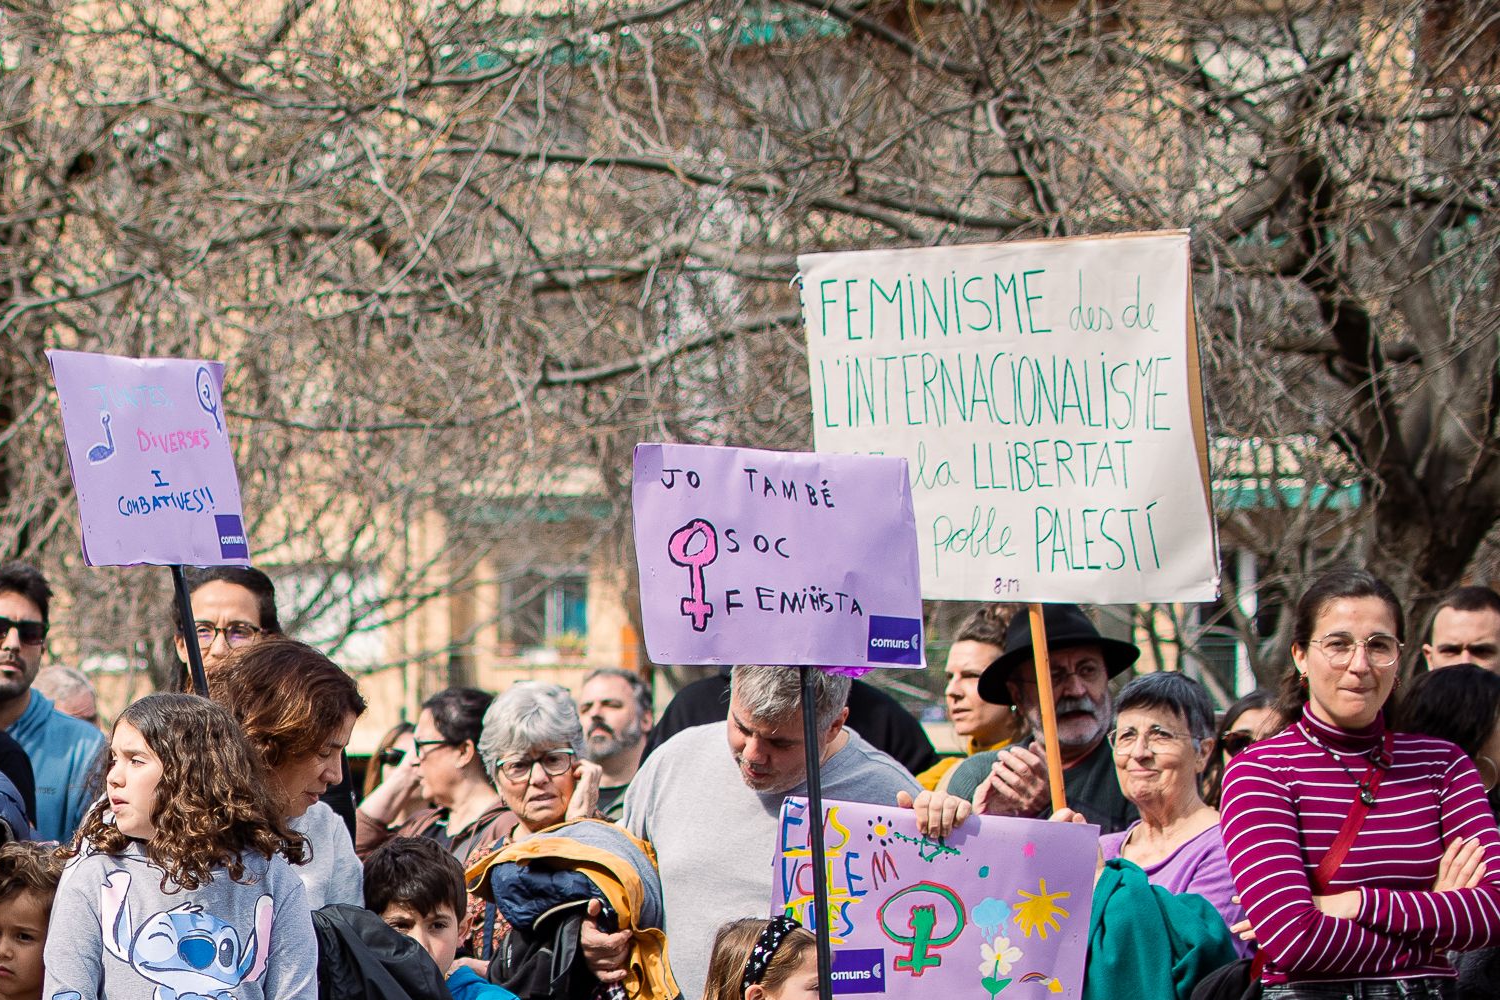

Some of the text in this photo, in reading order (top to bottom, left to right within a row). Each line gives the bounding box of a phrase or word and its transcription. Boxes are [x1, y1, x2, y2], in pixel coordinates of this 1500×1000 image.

[1068, 268, 1113, 332] des
[1121, 273, 1159, 333] de
[150, 469, 171, 488] I
[909, 440, 960, 491] la
[660, 467, 836, 509] JO TAMBÉ
[724, 527, 791, 559] SOC
[933, 505, 1017, 578] poble
[870, 635, 910, 650] comuns
[831, 968, 871, 981] omuns
